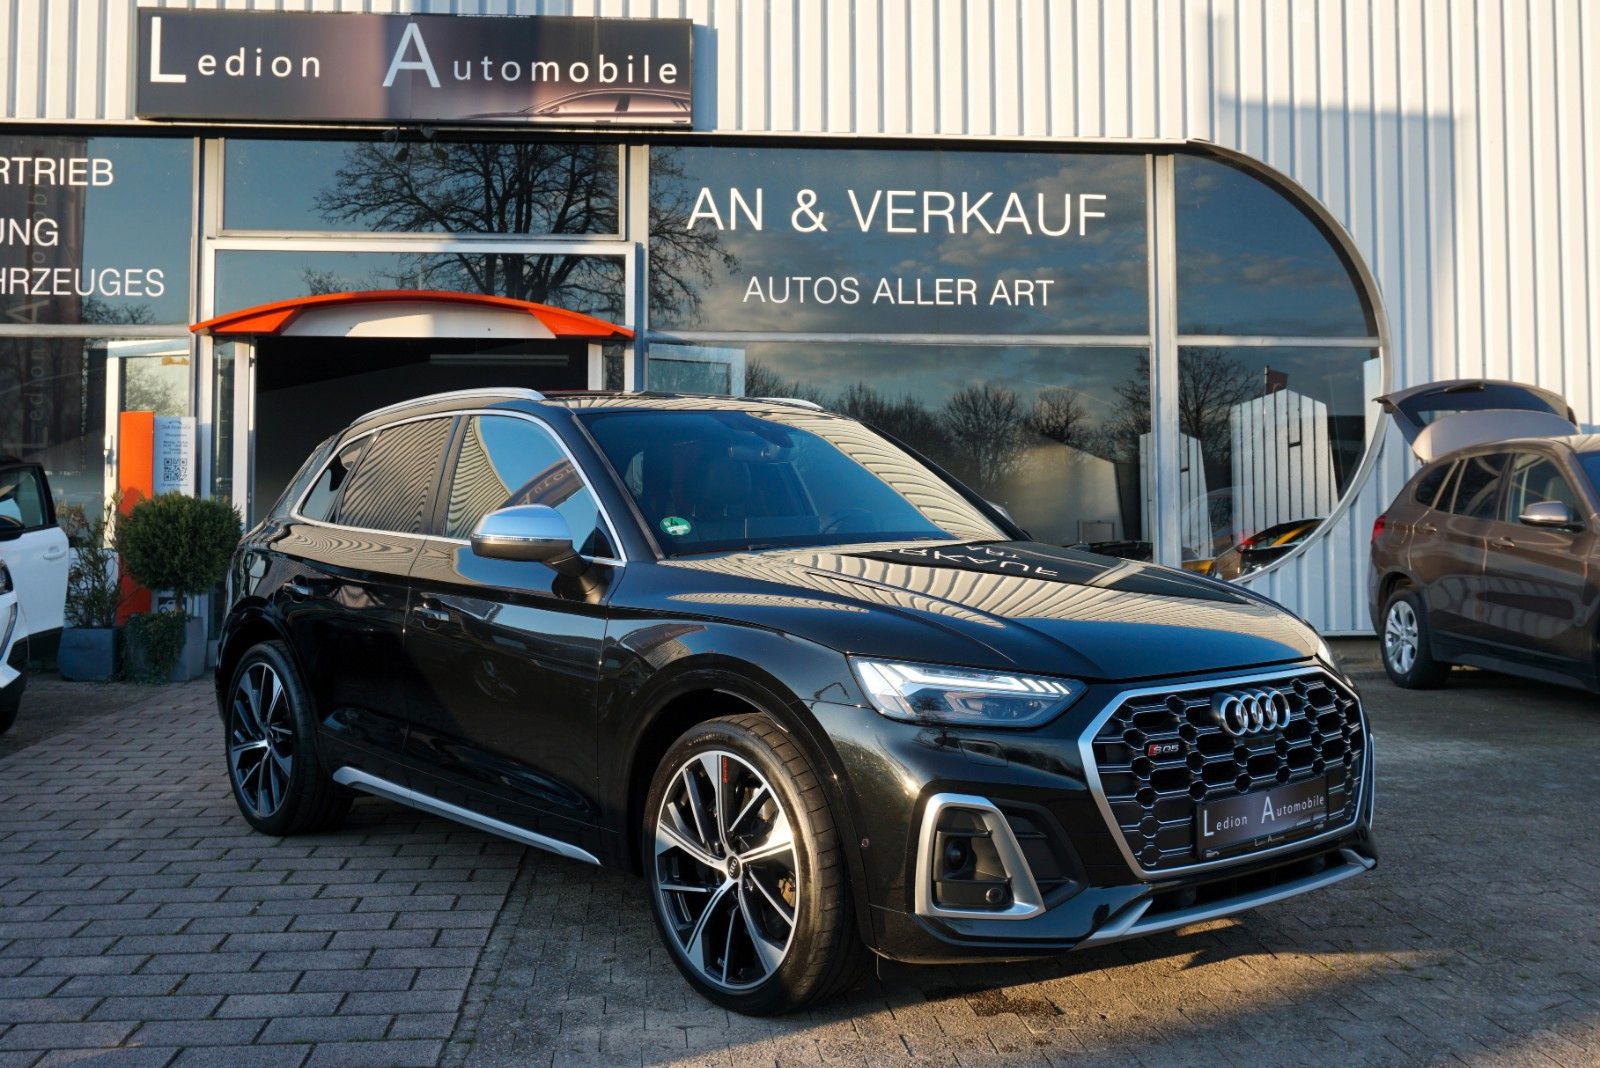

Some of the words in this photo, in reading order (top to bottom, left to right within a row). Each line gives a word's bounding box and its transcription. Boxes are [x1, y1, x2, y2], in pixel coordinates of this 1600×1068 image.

[150, 17, 320, 84] Ledion
[382, 22, 679, 88] Automobile
[0, 218, 58, 247] NG
[686, 187, 763, 232] AN
[791, 188, 829, 233] &
[848, 189, 1107, 237] VERKAUF
[743, 275, 860, 305] AUTOS
[873, 277, 977, 306] ALLER
[989, 279, 1055, 307] ART
[1203, 808, 1248, 837] Ledion
[1261, 794, 1325, 824] Automobile
